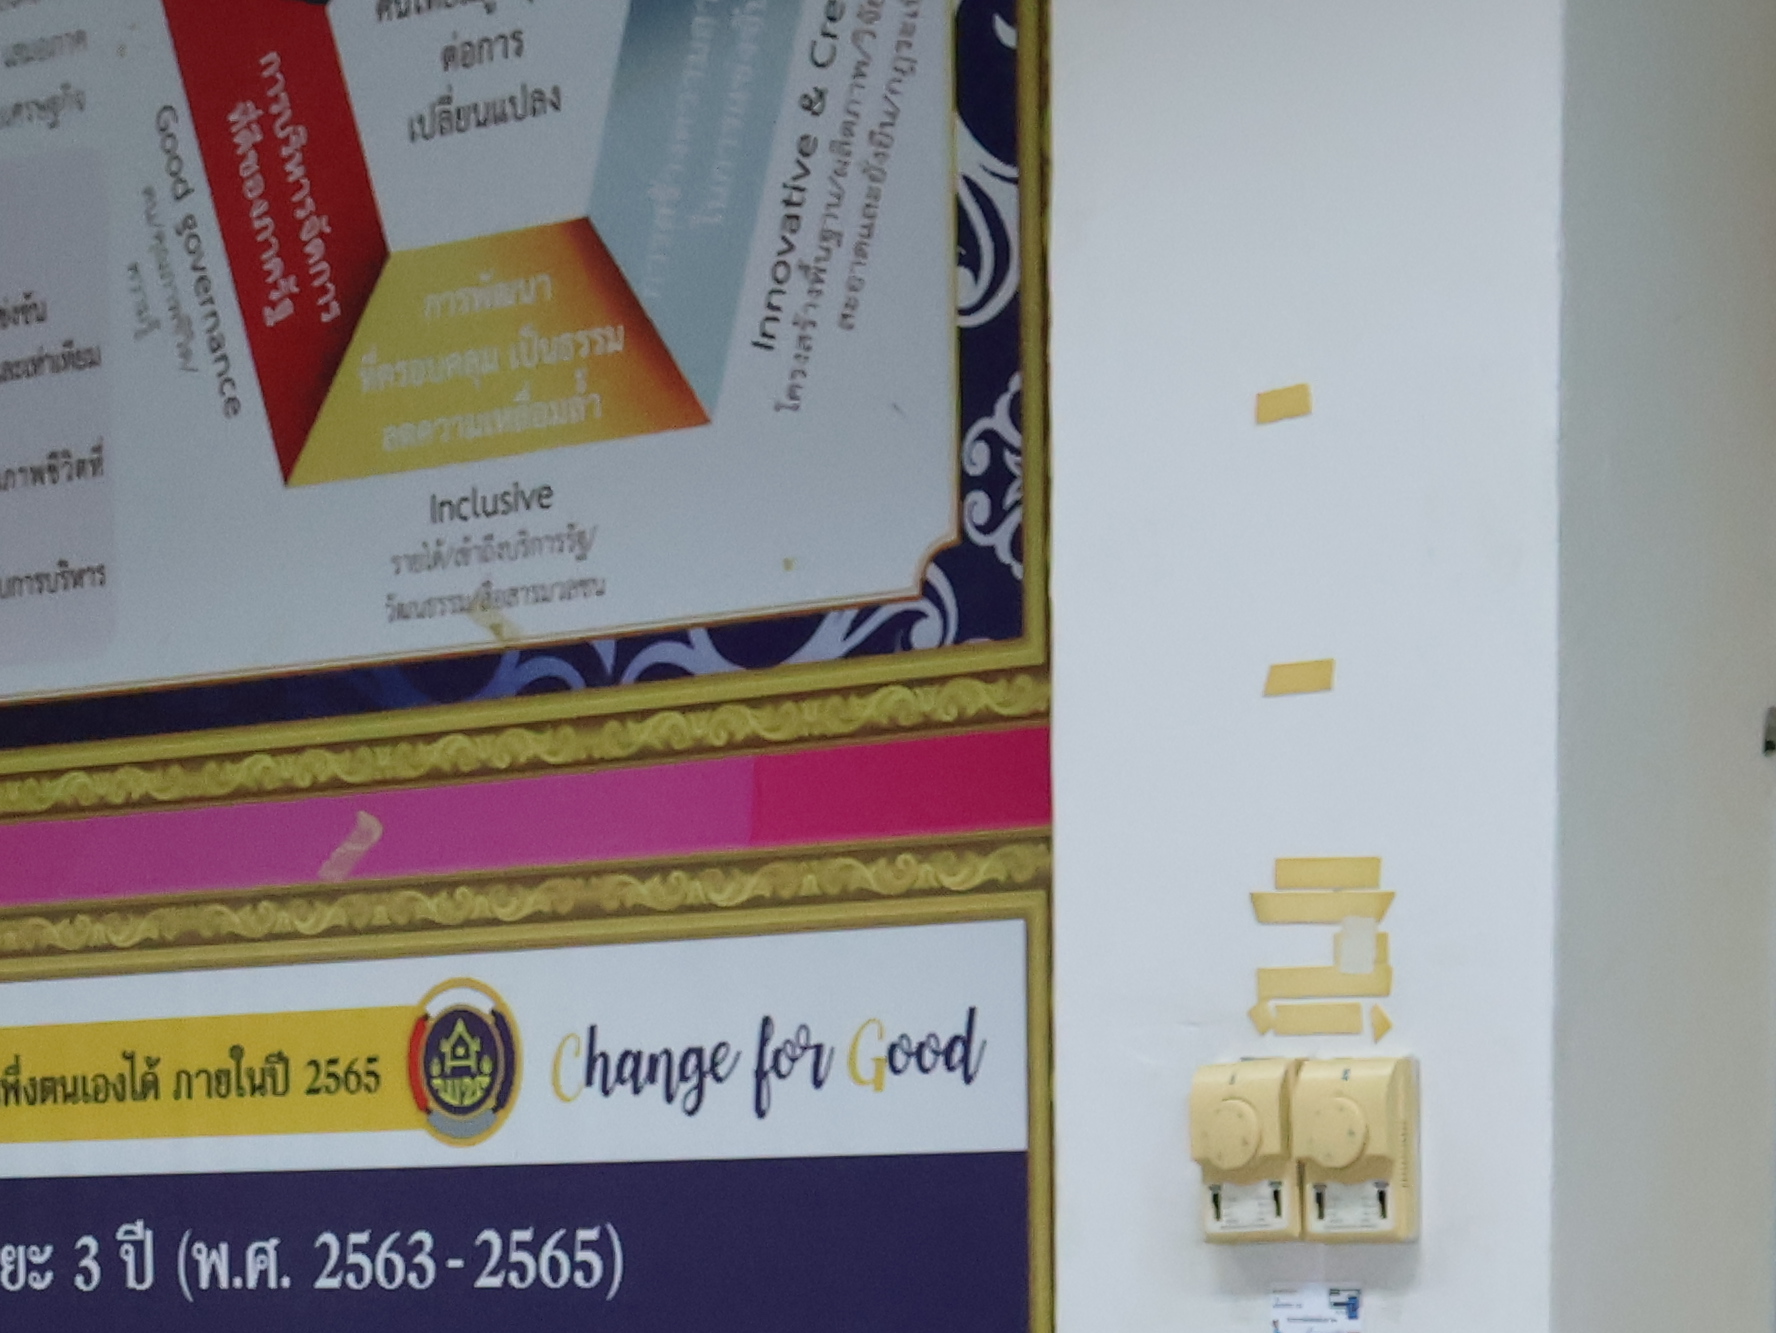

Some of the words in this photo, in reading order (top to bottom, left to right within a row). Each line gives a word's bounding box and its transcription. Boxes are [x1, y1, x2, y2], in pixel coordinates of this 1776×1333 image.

[441, 29, 525, 72] ต่อการ
[407, 82, 563, 143] เปลี่ยนแปลง
[751, 132, 819, 351] Innovative
[799, 86, 828, 117] &
[155, 104, 194, 201] Good
[175, 213, 242, 419] governance
[429, 481, 554, 525] Inclusive
[305, 1055, 382, 1095] 2565
[551, 1023, 742, 1116] Change
[754, 1014, 835, 1119] for
[849, 1006, 987, 1093] Good
[73, 1235, 101, 1291] 3
[115, 1218, 154, 1290] ปี
[177, 1228, 291, 1302] (พ.ศ.
